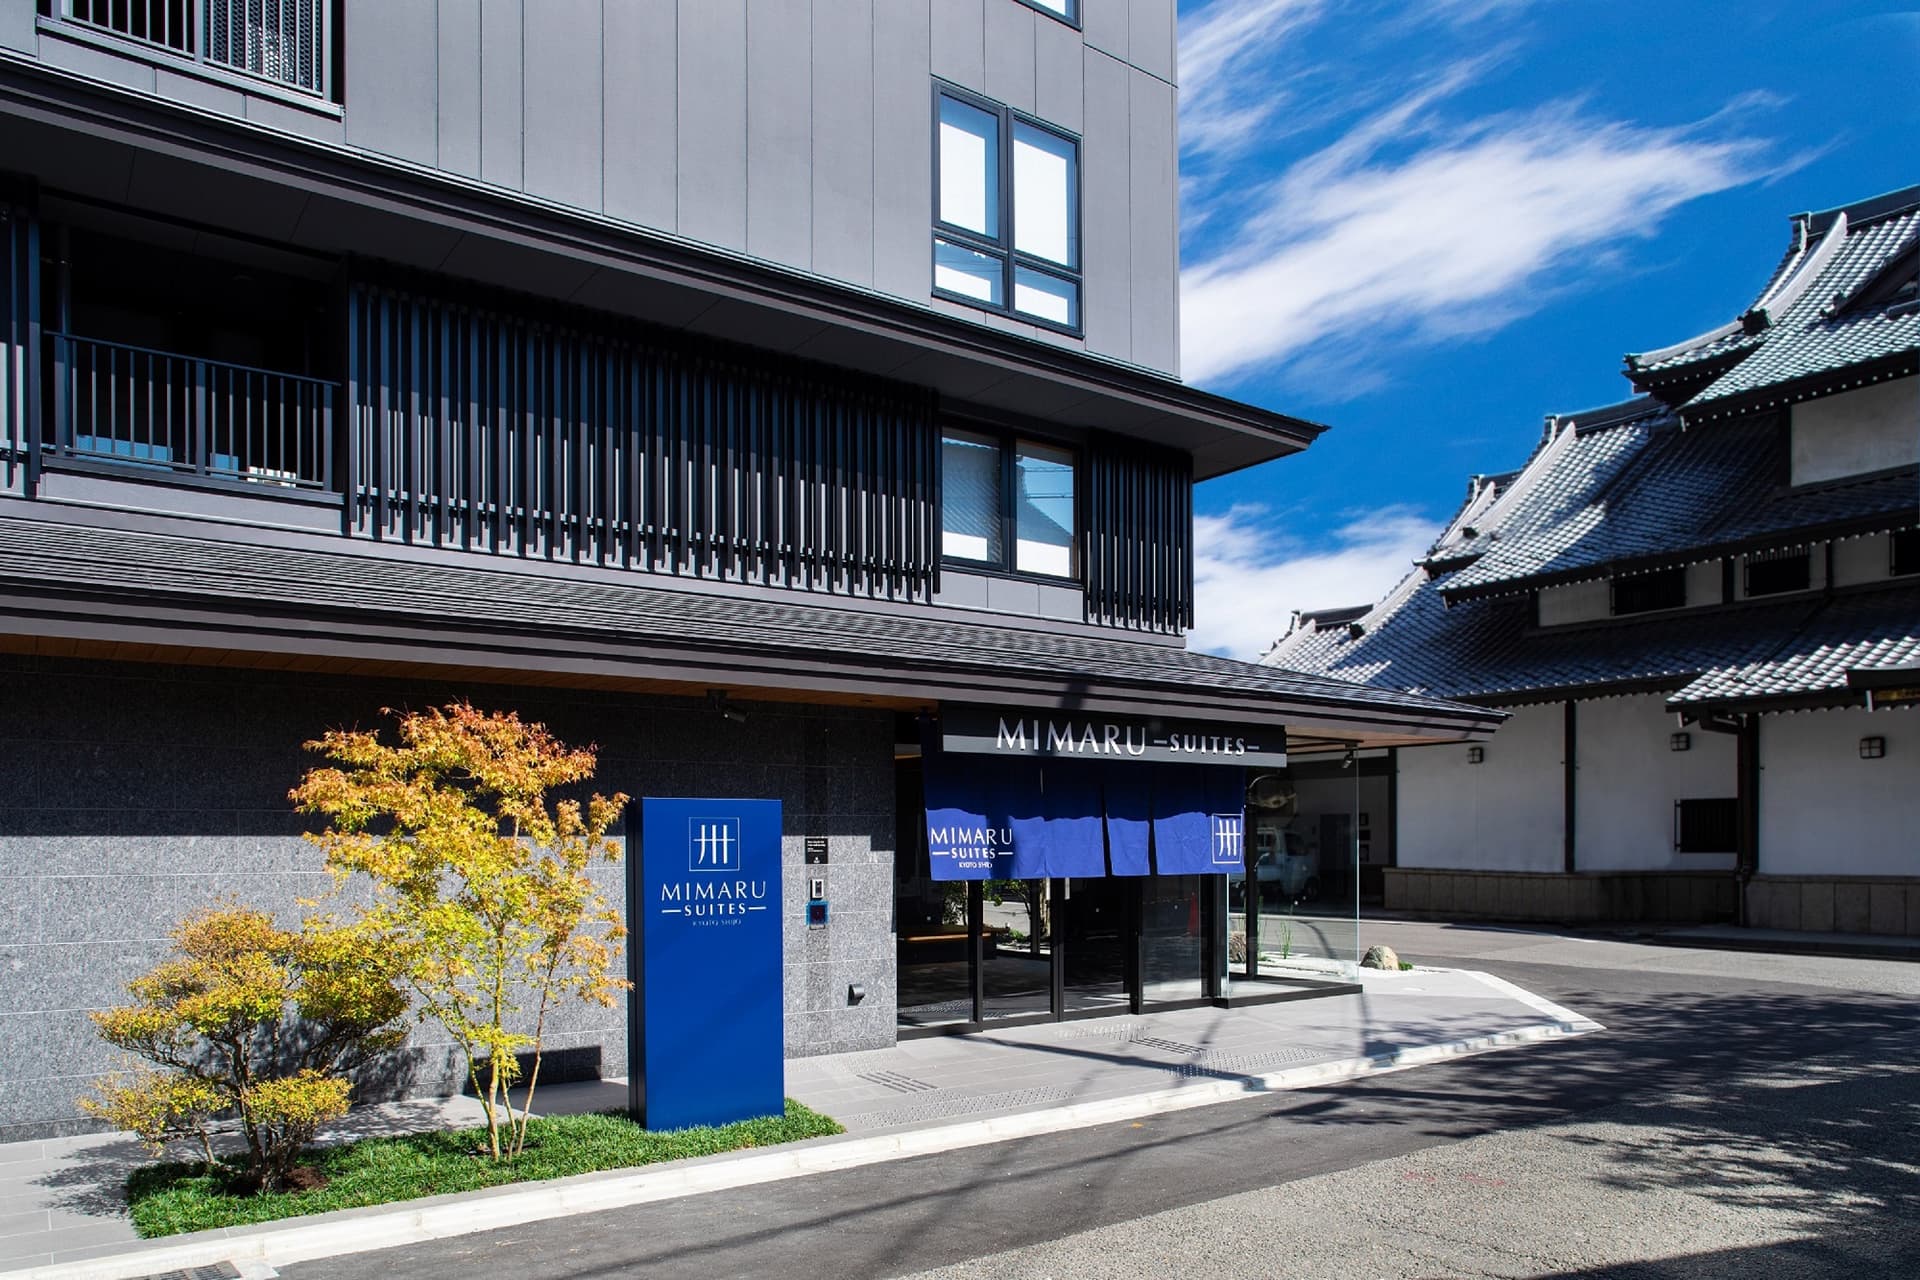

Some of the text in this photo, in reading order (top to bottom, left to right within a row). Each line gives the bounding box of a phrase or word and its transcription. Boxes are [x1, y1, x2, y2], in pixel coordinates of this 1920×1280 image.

[996, 717, 1245, 756] MIMARU SUITES
[931, 827, 1012, 845] MIMARU
[951, 847, 996, 859] SUITES
[661, 880, 766, 901] MIMARU
[684, 903, 746, 917] SUITES
